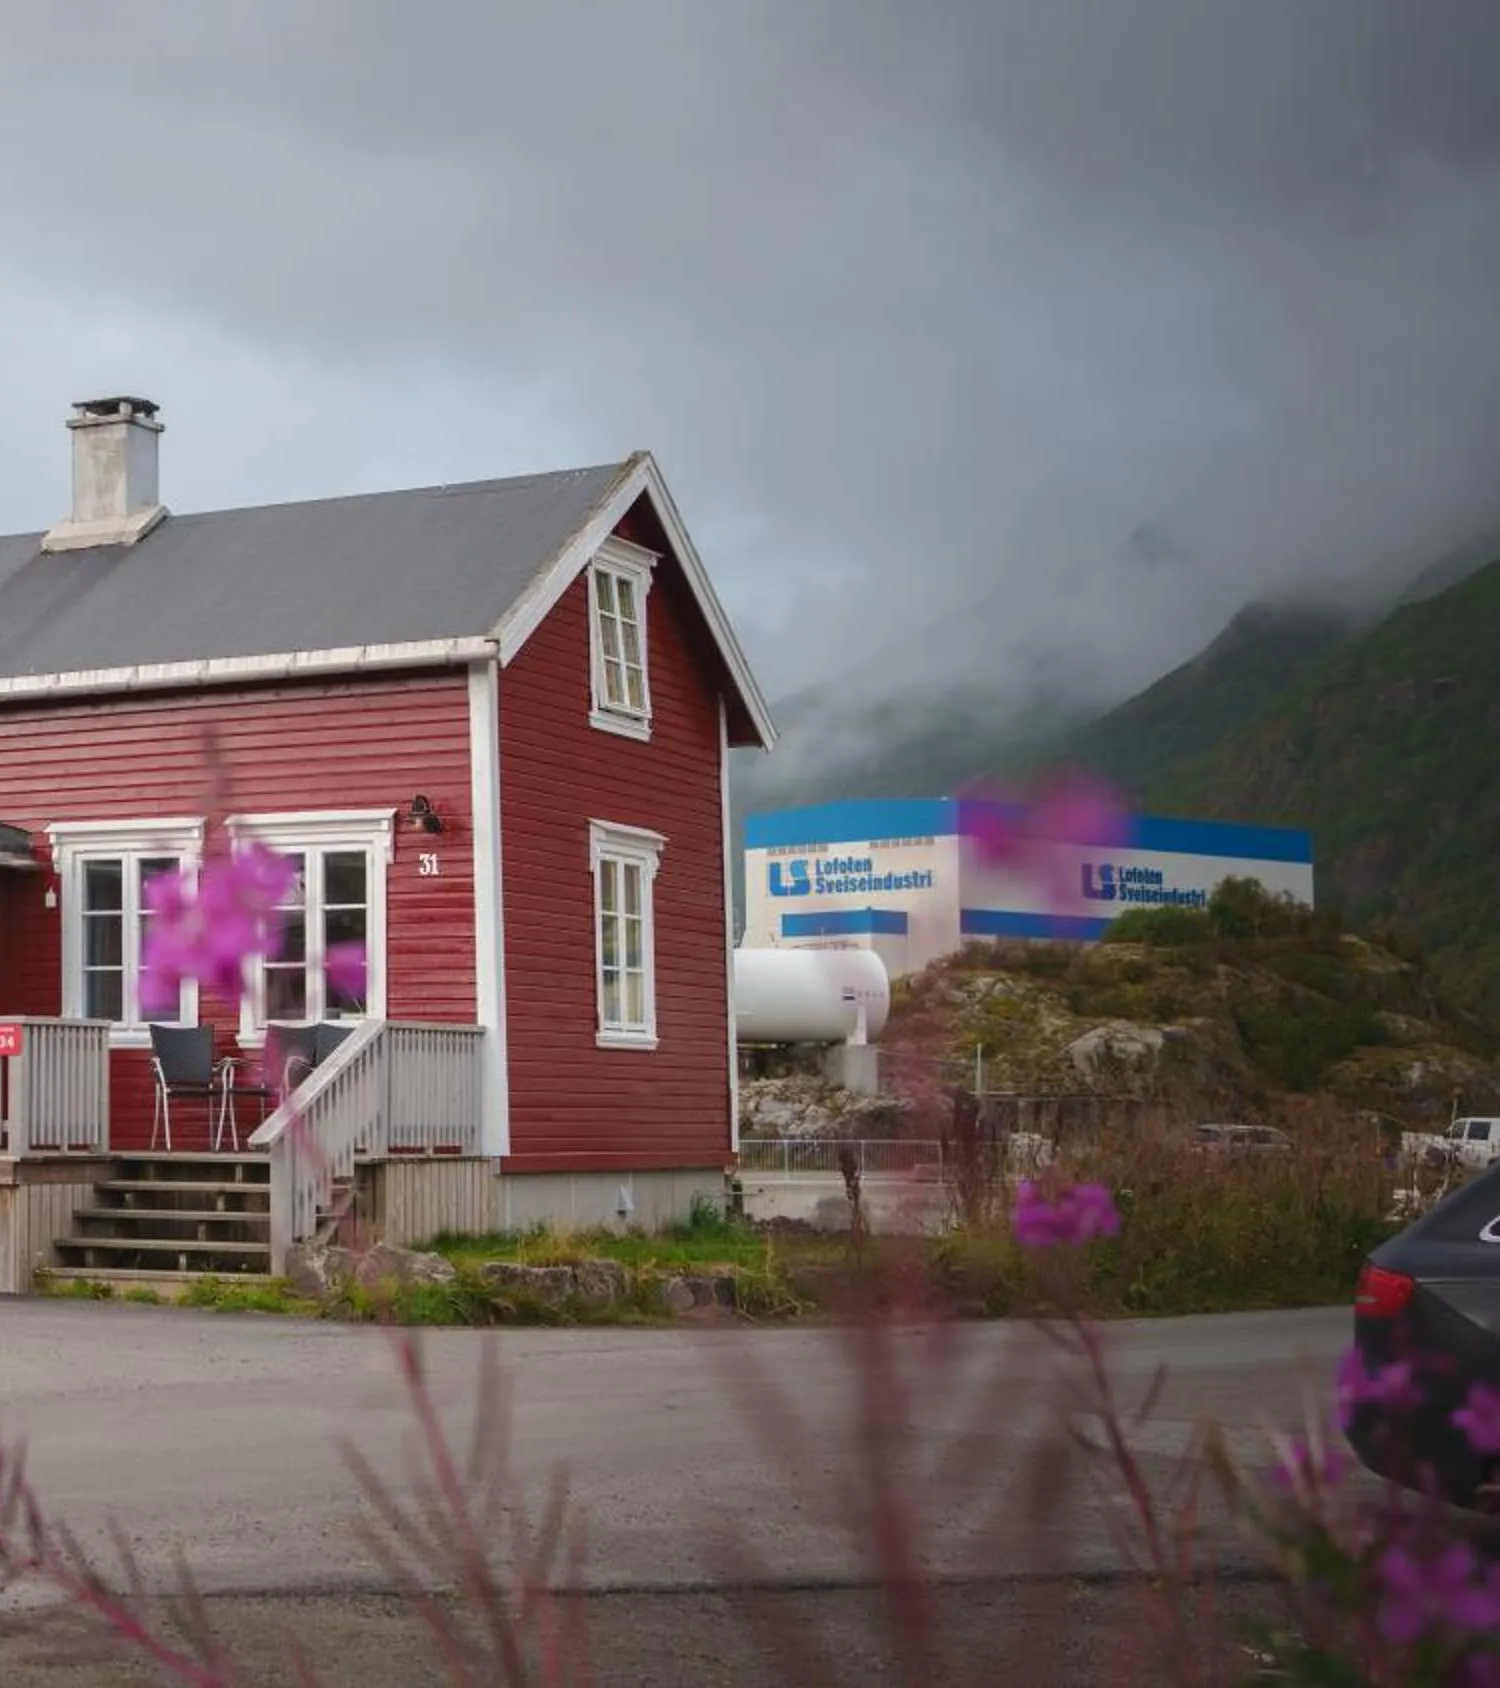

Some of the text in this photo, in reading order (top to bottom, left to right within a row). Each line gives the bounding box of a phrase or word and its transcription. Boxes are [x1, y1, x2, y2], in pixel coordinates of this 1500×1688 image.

[419, 853, 439, 875] 31
[815, 856, 873, 875] Lofoten
[1118, 865, 1163, 885] Lofoten
[815, 870, 933, 895] Sveiseindustri
[1118, 884, 1206, 907] Sveiseindustri
